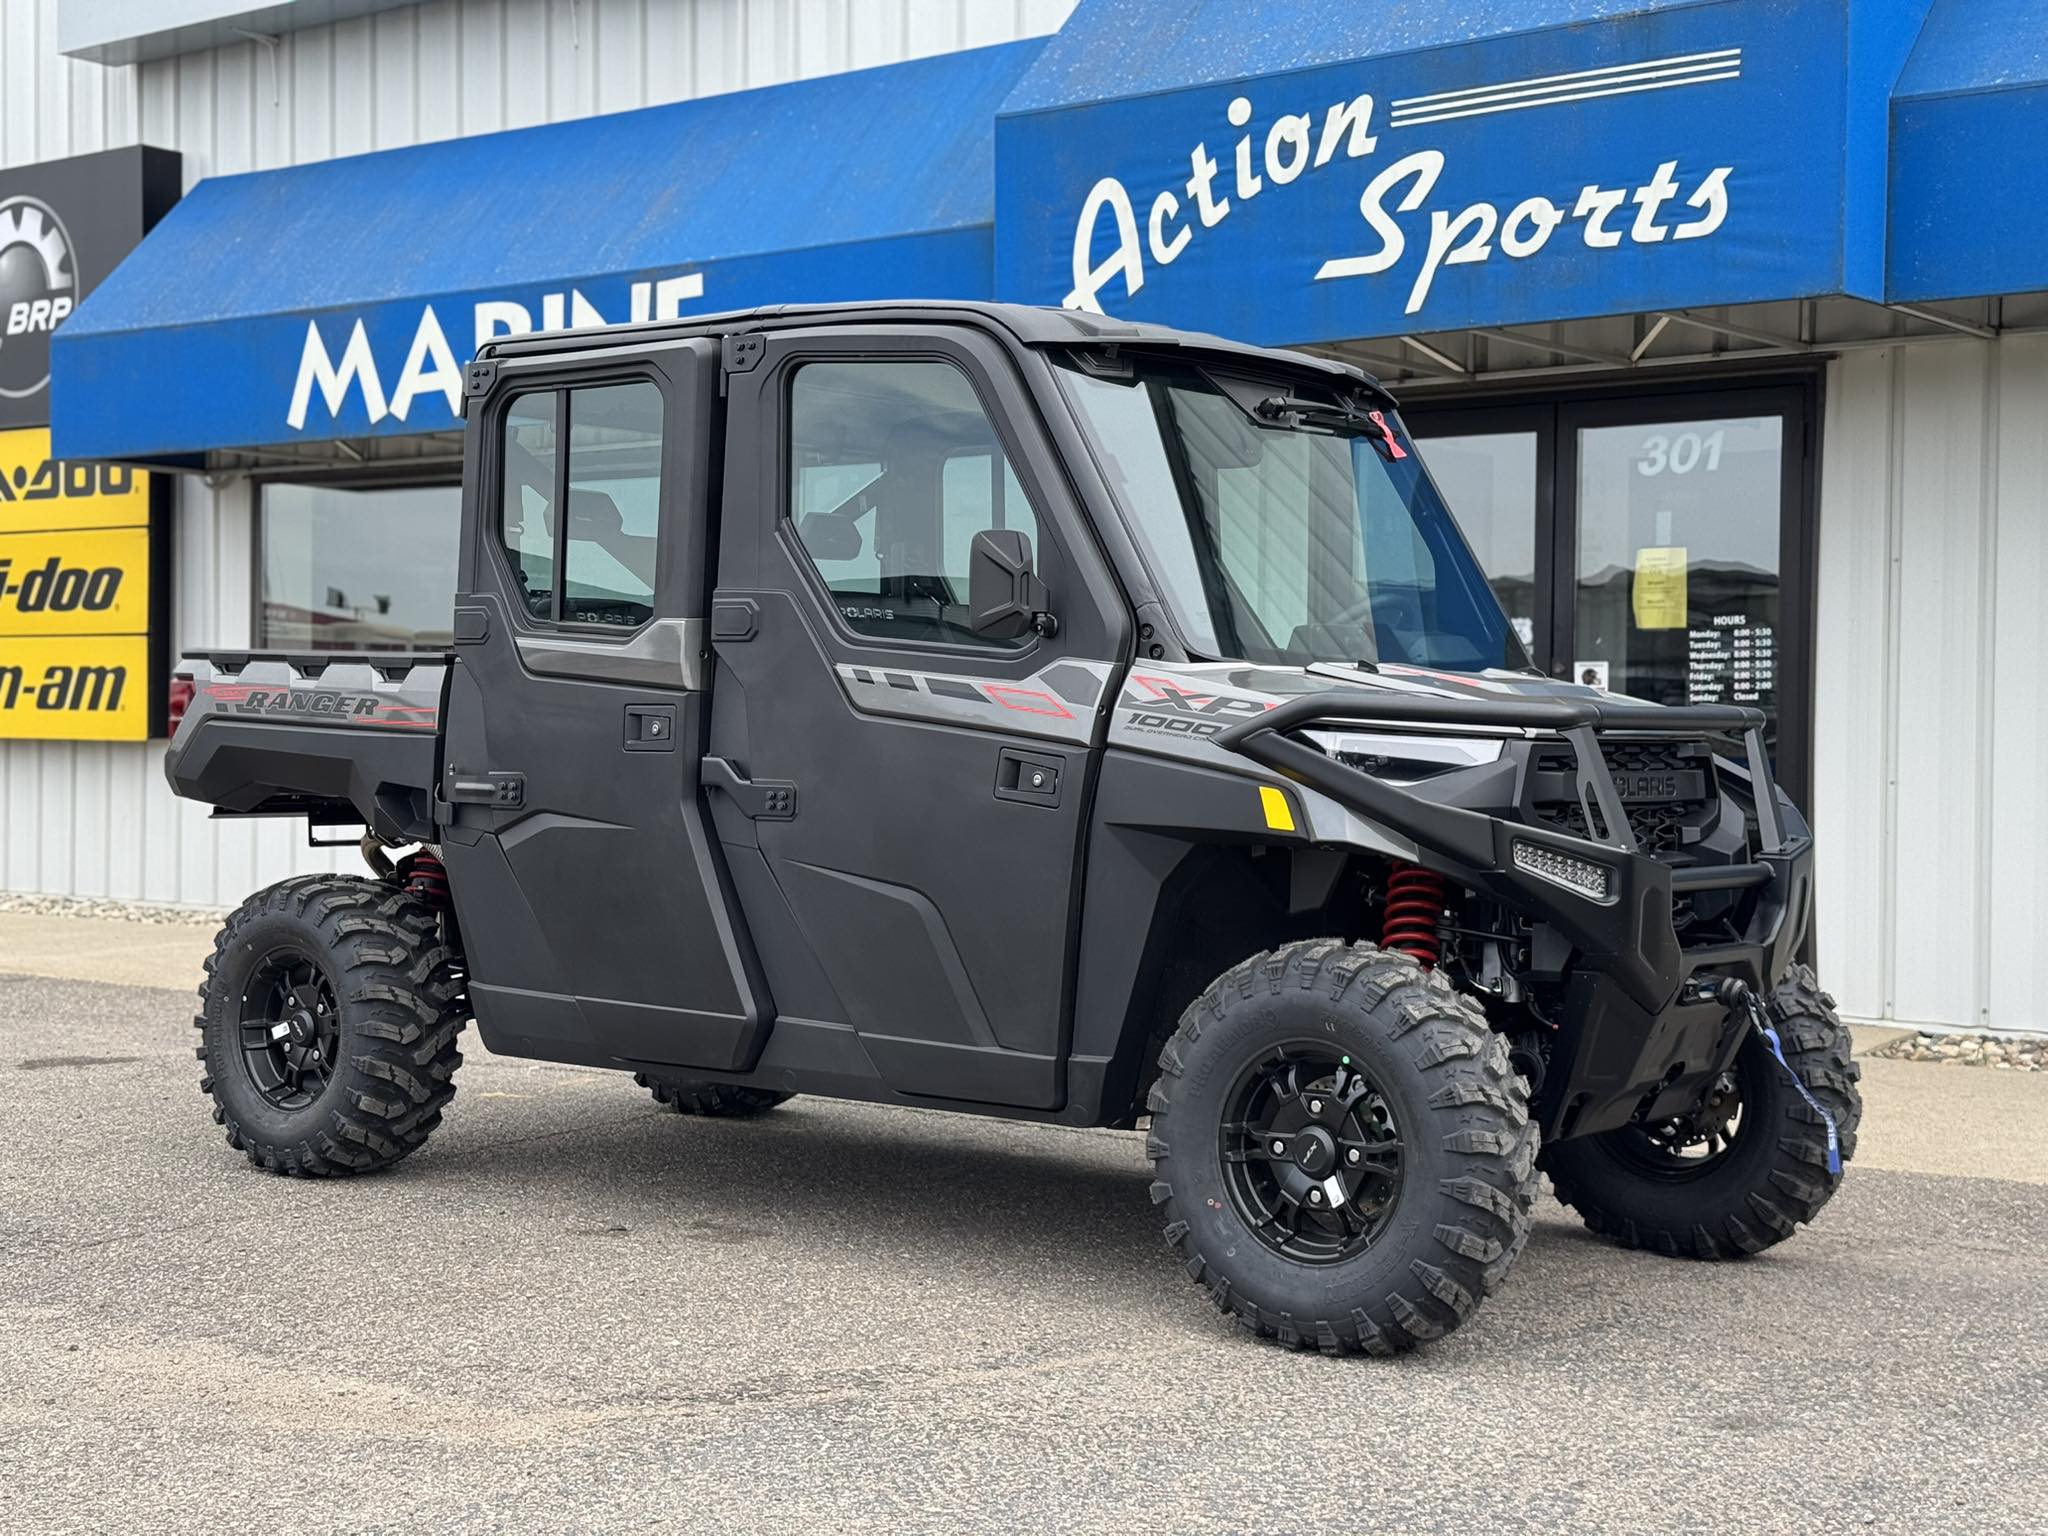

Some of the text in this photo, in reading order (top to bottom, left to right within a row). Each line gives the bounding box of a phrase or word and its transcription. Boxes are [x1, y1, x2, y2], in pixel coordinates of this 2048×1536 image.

[1062, 94, 1378, 316] Action
[1314, 150, 1734, 314] Sports
[7, 297, 72, 335] BRP
[1637, 429, 1725, 477] 301
[1713, 615, 1746, 626] HOURS
[245, 690, 380, 716] RANGER
[1141, 687, 1266, 715] XP
[1733, 692, 1759, 701] Closed
[1128, 712, 1223, 736] 1000
[1613, 776, 1677, 798] OLARIS
